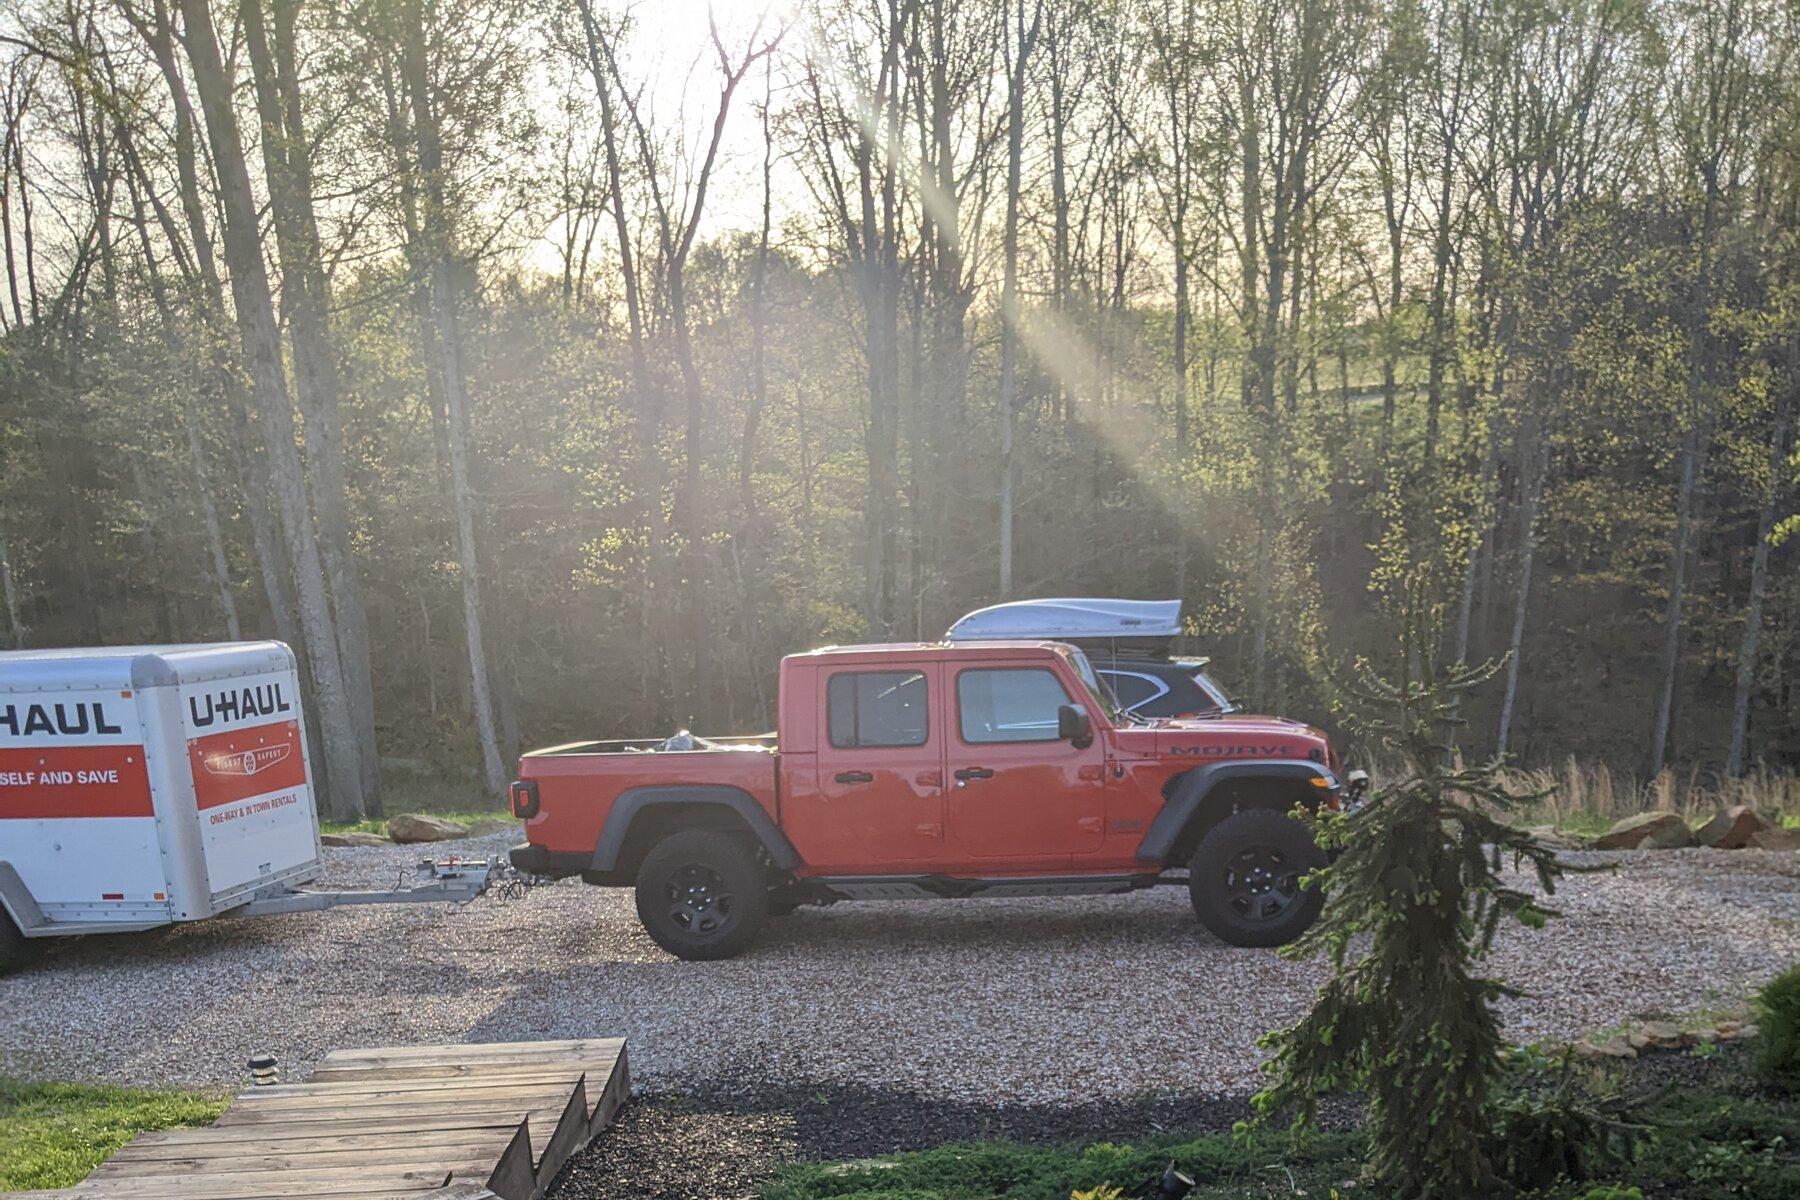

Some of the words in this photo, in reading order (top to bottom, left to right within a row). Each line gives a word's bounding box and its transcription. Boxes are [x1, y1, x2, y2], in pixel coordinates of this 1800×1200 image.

[189, 683, 290, 727] U-HAUL
[1169, 745, 1297, 756] MOJAVE
[0, 772, 35, 786] SELF
[40, 771, 73, 785] AND
[77, 770, 119, 784] SAVE
[210, 811, 239, 825] ONE-WAY
[271, 794, 297, 808] RENTALS
